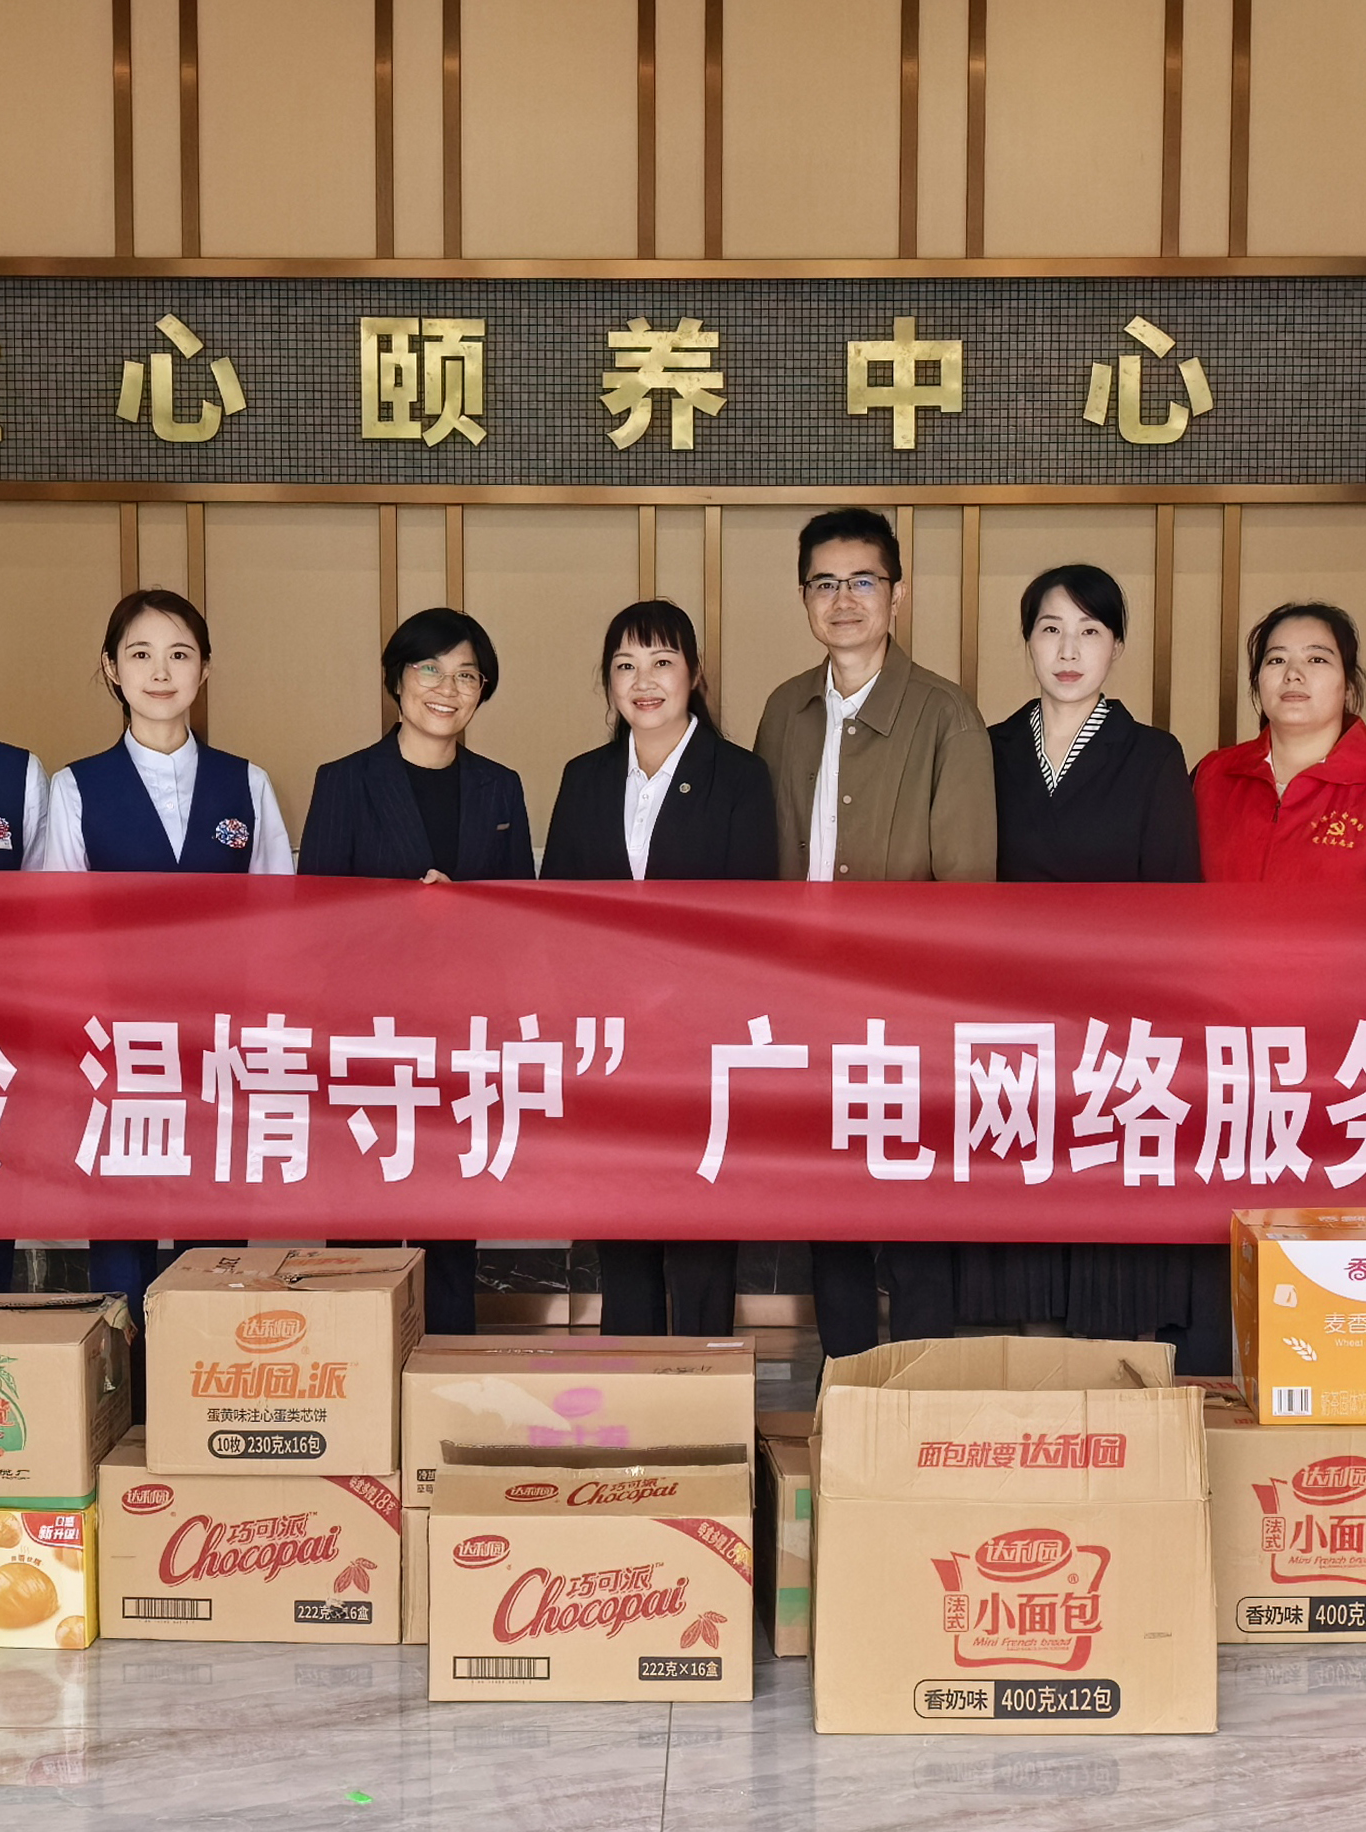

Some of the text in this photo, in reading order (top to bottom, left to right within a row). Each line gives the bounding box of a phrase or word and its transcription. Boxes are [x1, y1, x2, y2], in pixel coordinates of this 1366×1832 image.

[75, 1013, 624, 1184] 温情守护”
[242, 1318, 301, 1338] 达利园
[1335, 1338, 1363, 1347] Wheat
[207, 1408, 327, 1423] 蛋黄味注心蛋类芯饼
[217, 1435, 321, 1454] 10枚 230克x16包
[511, 1486, 554, 1497] 达利园
[567, 1482, 679, 1506] Chocopai
[610, 1478, 658, 1492] 巧可派
[126, 1489, 170, 1504] 达利园
[55, 1515, 76, 1527] 口感
[227, 1513, 309, 1543] 巧可派
[1265, 1519, 1283, 1550] 法式
[159, 1514, 342, 1587] Chocopai
[458, 1540, 506, 1562] 达利园
[985, 1539, 1064, 1564] 达利园
[1288, 1555, 1312, 1564] Mini
[1313, 1555, 1347, 1565] French
[566, 1563, 655, 1598] 巧可派
[493, 1567, 690, 1645] Chocopai
[947, 1597, 967, 1631] 法式
[974, 1592, 1104, 1636] 小面包
[1245, 1605, 1304, 1625] 香奶味
[972, 1637, 1072, 1647] Mini French bread
[924, 1686, 1113, 1713] 香奶味 400克x12包
